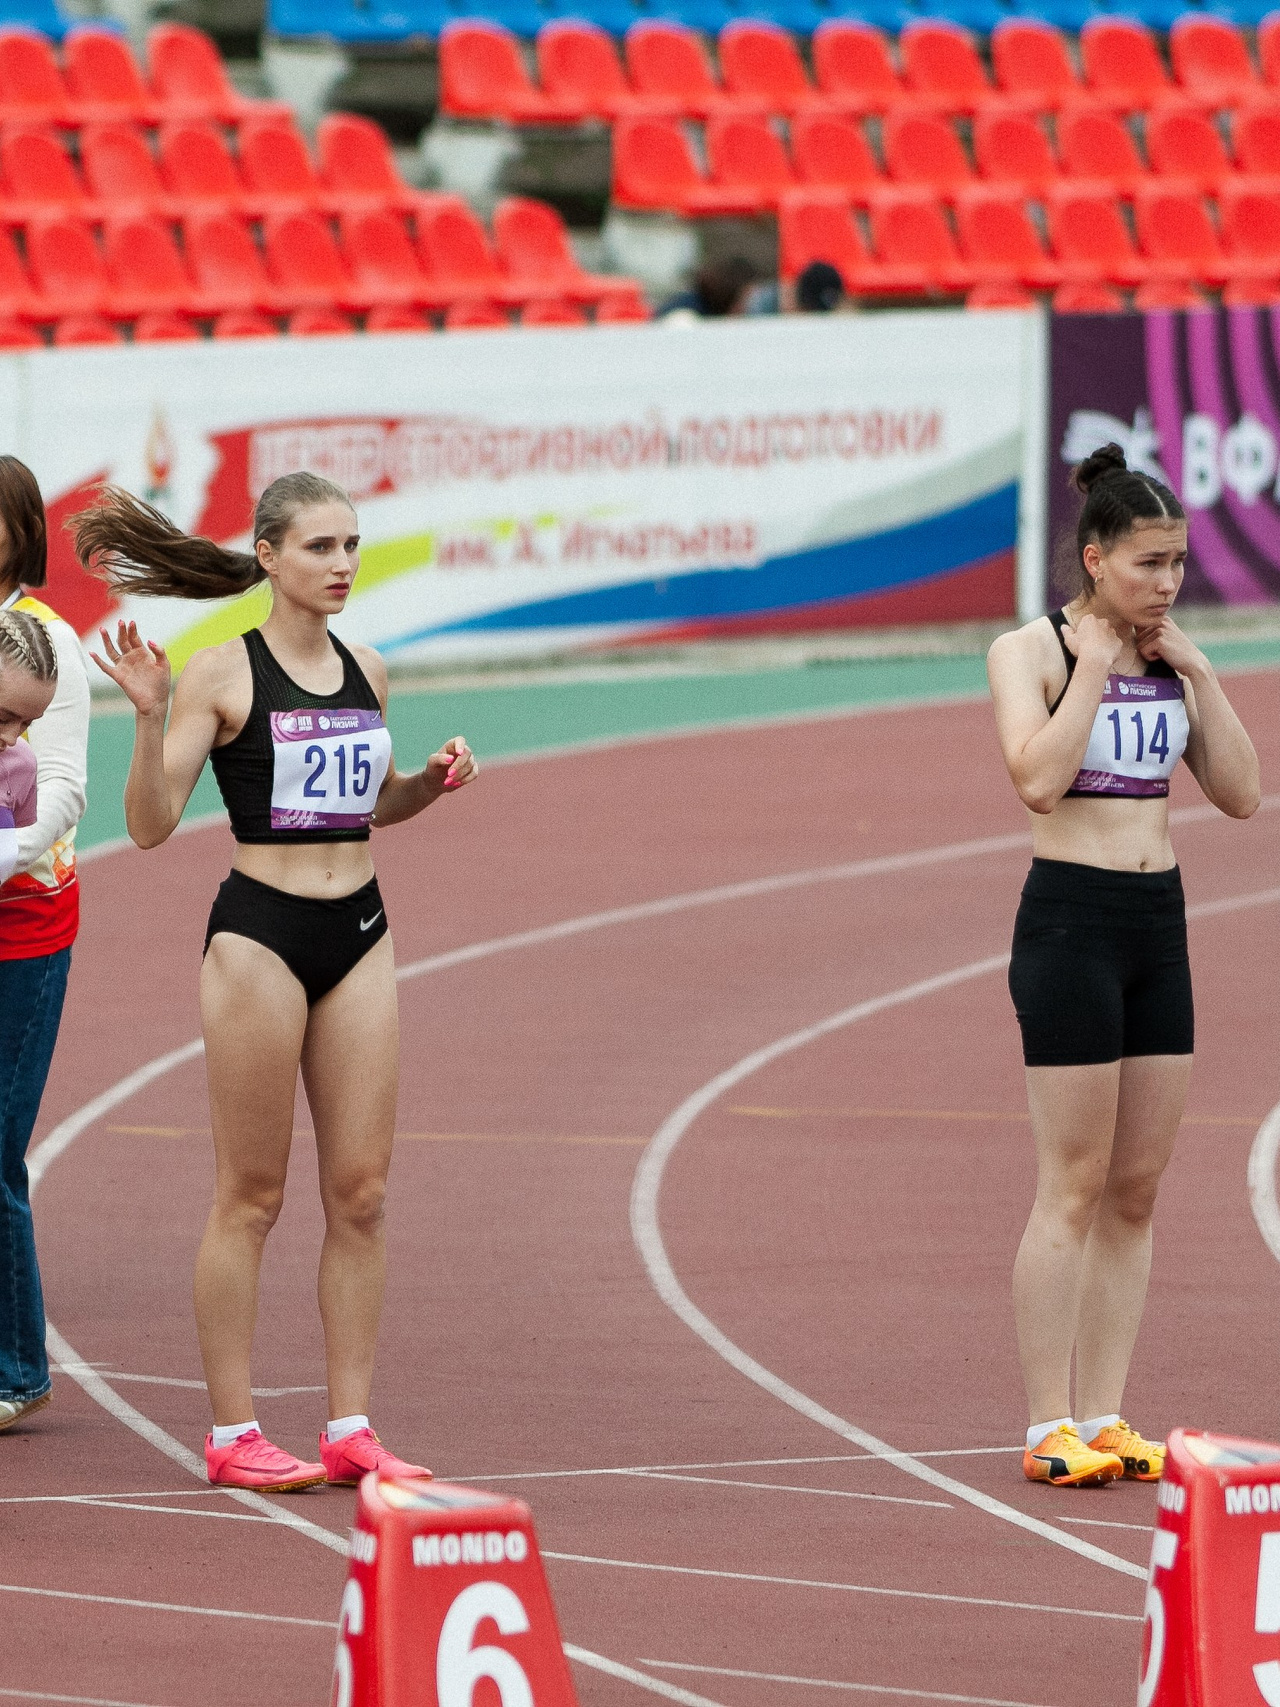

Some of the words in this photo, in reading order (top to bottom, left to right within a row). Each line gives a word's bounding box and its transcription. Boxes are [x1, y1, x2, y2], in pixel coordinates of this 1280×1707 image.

[1182, 411, 1280, 507] ВФ
[1107, 708, 1170, 764] 114
[303, 743, 371, 798] 215
[412, 1530, 528, 1567] MONDO
[435, 1580, 535, 1707] 6
